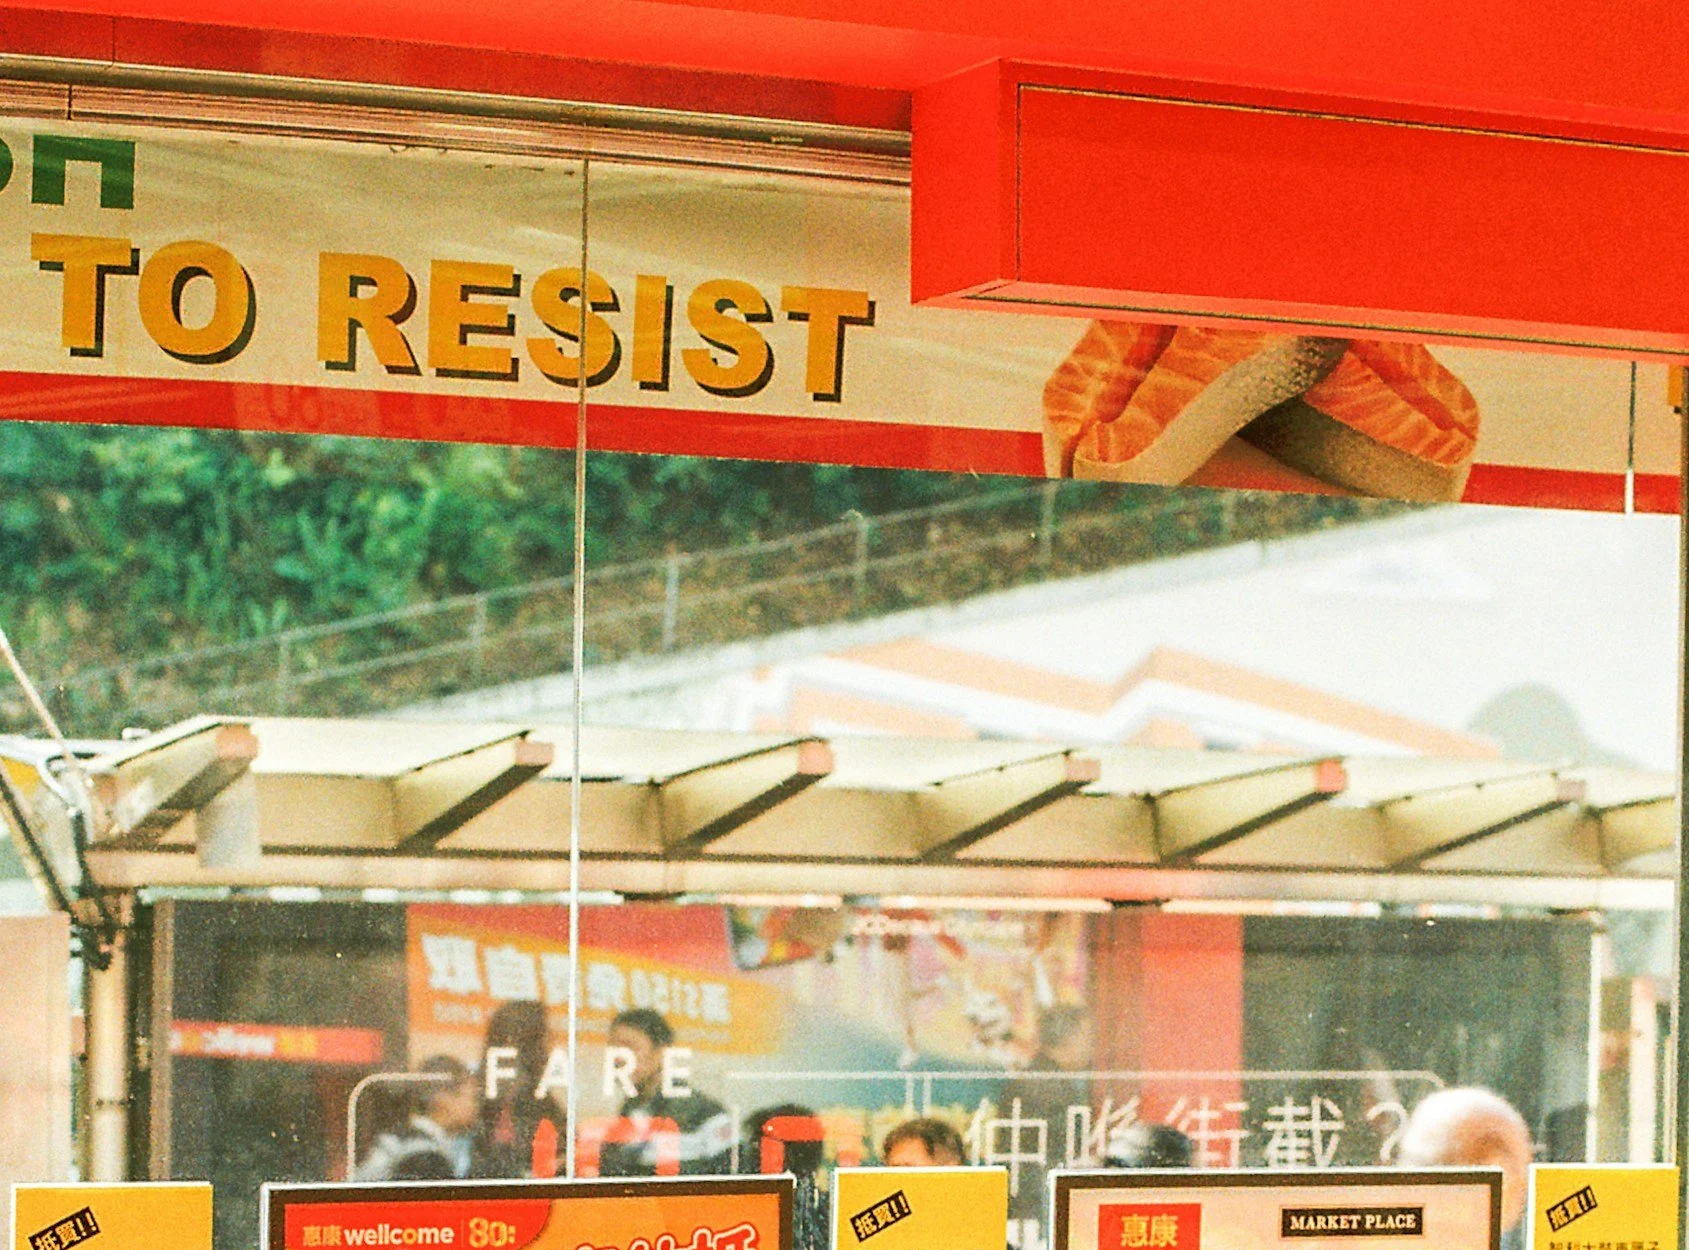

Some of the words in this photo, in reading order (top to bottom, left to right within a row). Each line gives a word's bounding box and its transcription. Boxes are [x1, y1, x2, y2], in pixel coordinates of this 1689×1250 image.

[30, 231, 256, 365] TO
[317, 250, 877, 403] RESIST
[485, 1046, 694, 1101] FARE
[302, 1224, 342, 1247] 惠康
[344, 1223, 455, 1245] wellcome
[1121, 1213, 1178, 1247] 惠康
[1290, 1214, 1361, 1230] MARKET
[1365, 1213, 1416, 1229] PLACE
